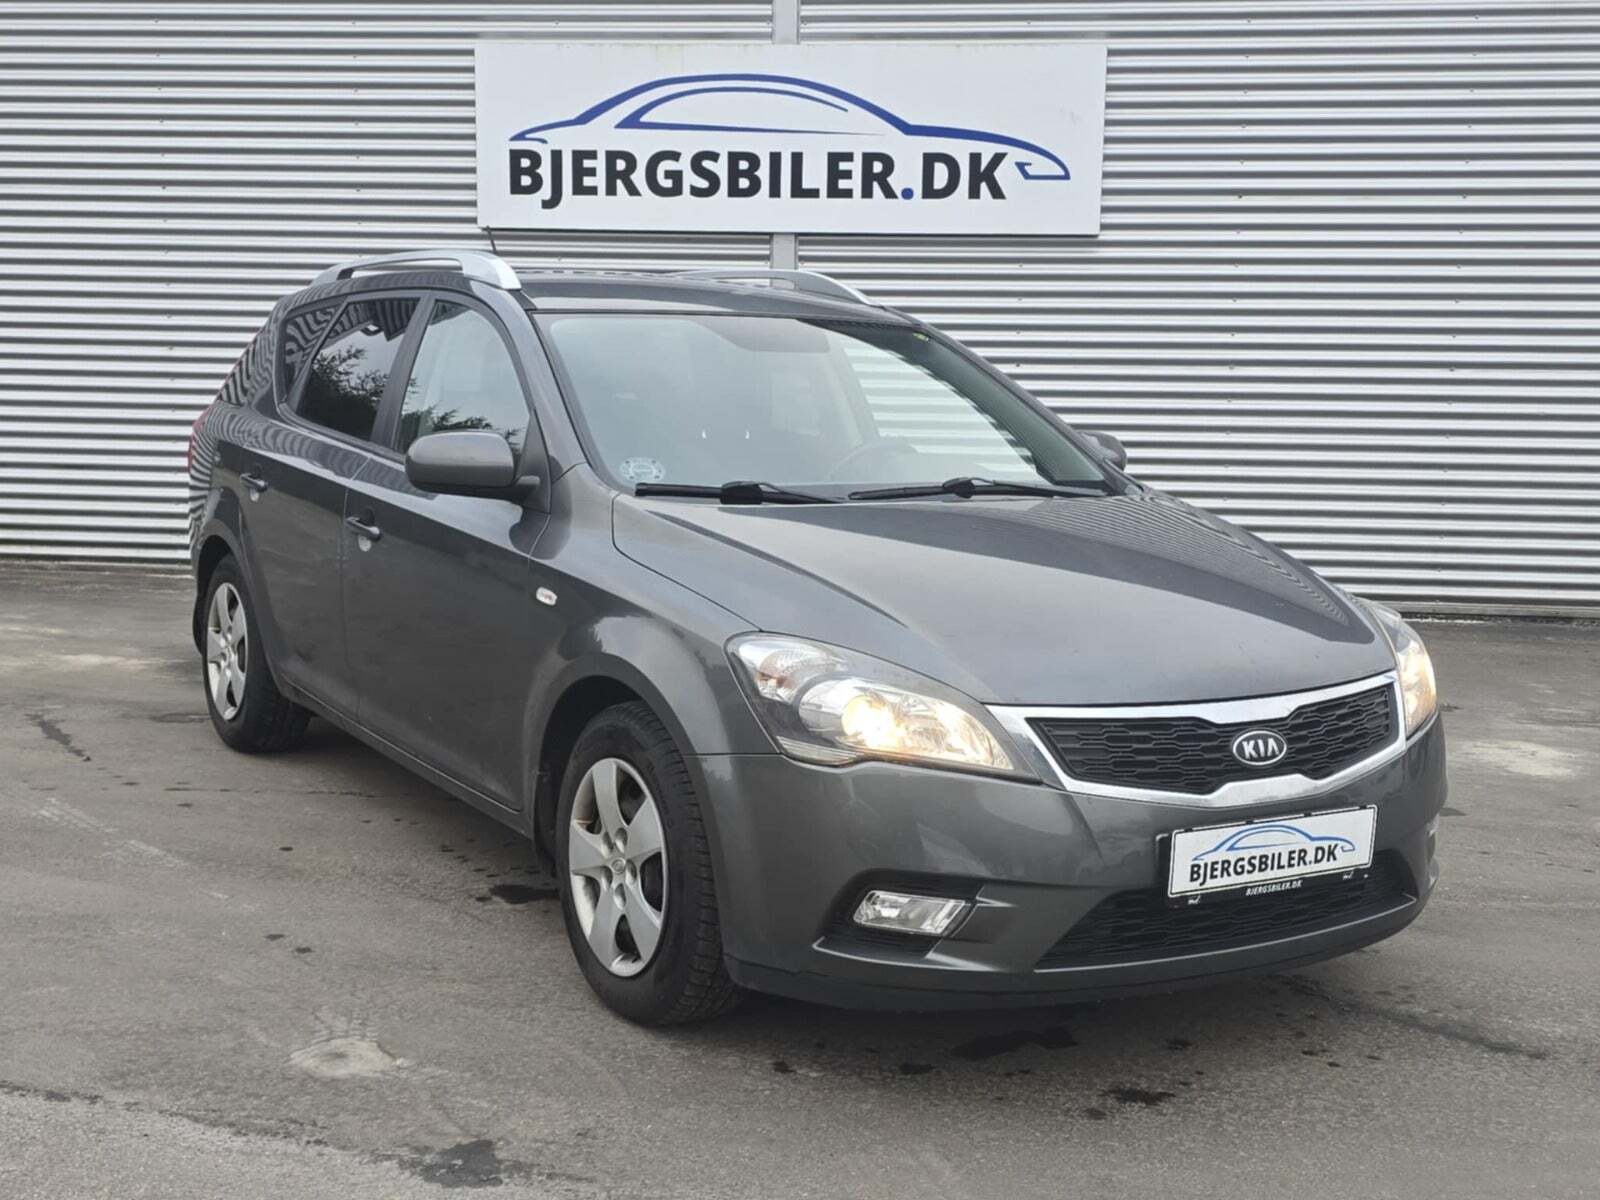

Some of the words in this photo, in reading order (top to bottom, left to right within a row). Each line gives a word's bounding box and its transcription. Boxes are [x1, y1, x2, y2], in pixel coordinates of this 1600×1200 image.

[508, 148, 1008, 210] BJERGSBILER.DK
[1241, 737, 1280, 759] KIA
[1189, 843, 1338, 886] BJERGSBILER.DK
[1245, 879, 1303, 896] BJERGSBILER.DK
